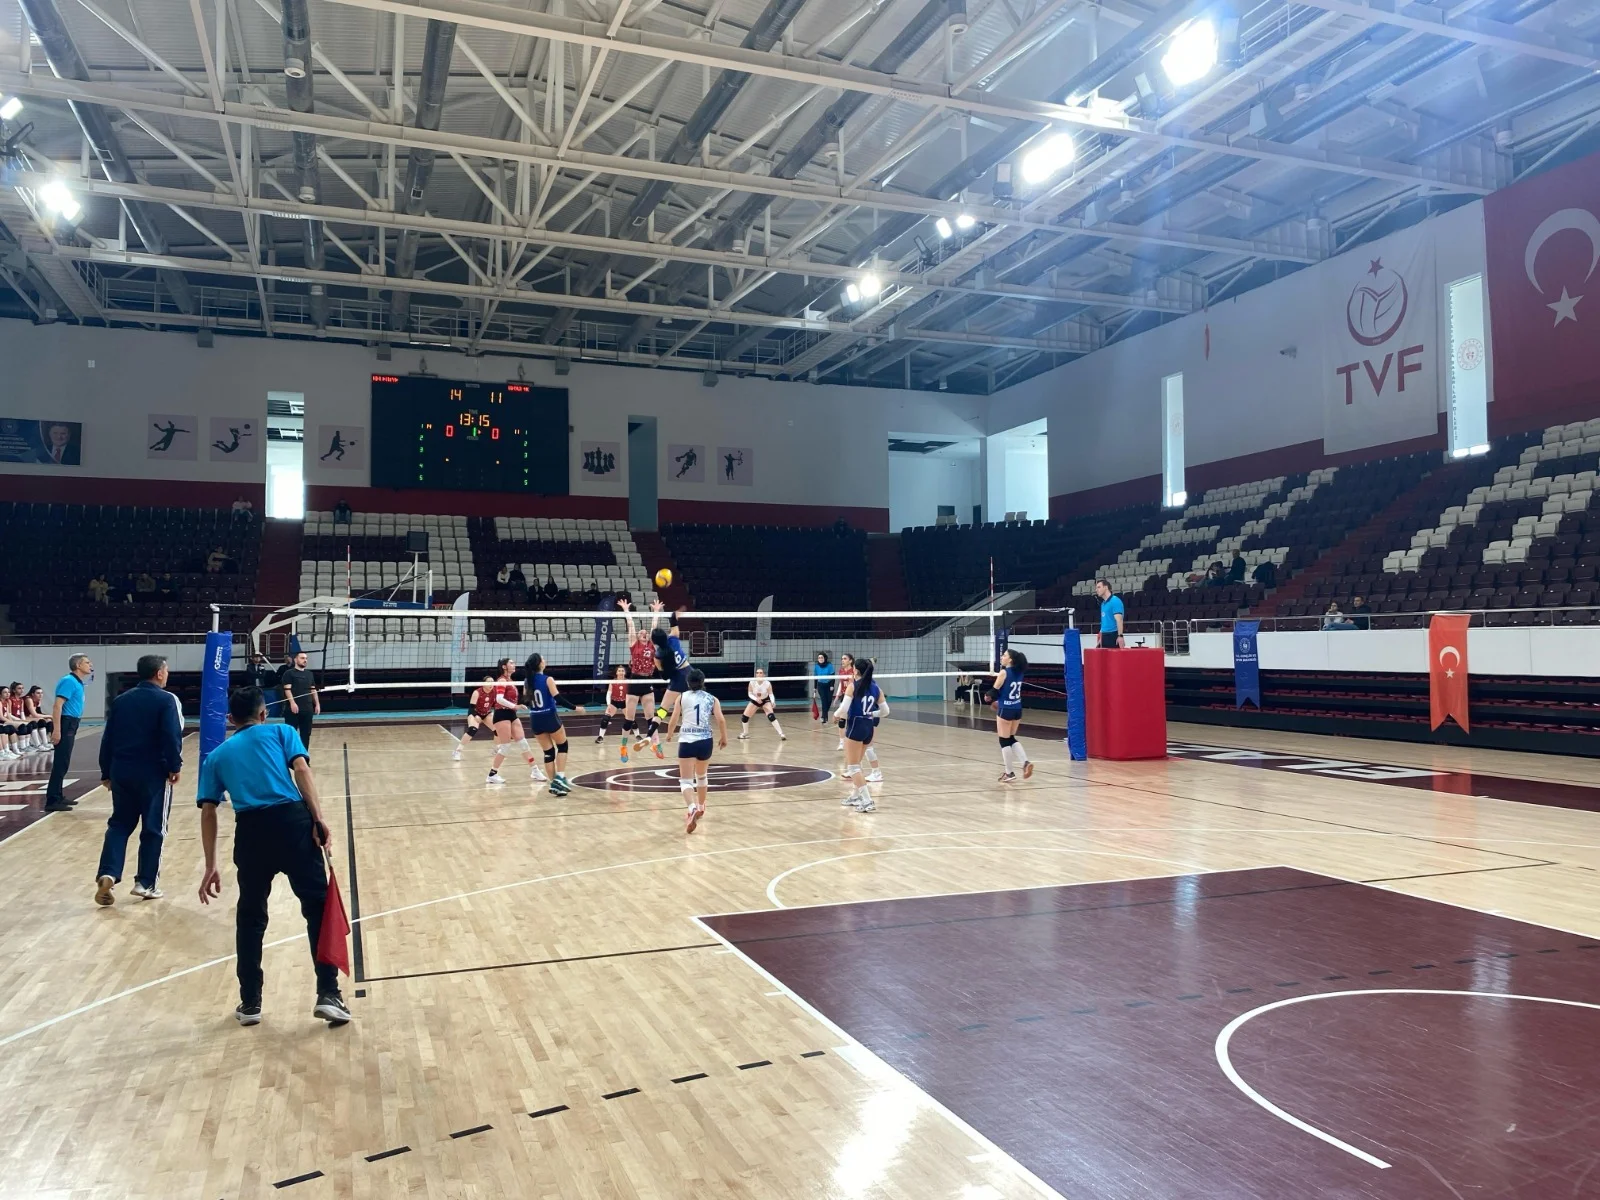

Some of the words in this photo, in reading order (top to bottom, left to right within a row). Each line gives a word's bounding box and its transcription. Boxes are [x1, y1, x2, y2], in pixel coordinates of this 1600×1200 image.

[1336, 344, 1424, 405] TVF
[450, 389, 462, 401] 14
[490, 392, 502, 404] 11
[446, 425, 454, 437] 0
[491, 428, 500, 440] 0
[597, 619, 609, 676] VOLEYBOL
[1008, 681, 1022, 700] 23
[693, 703, 700, 726] 1
[861, 695, 875, 716] 12
